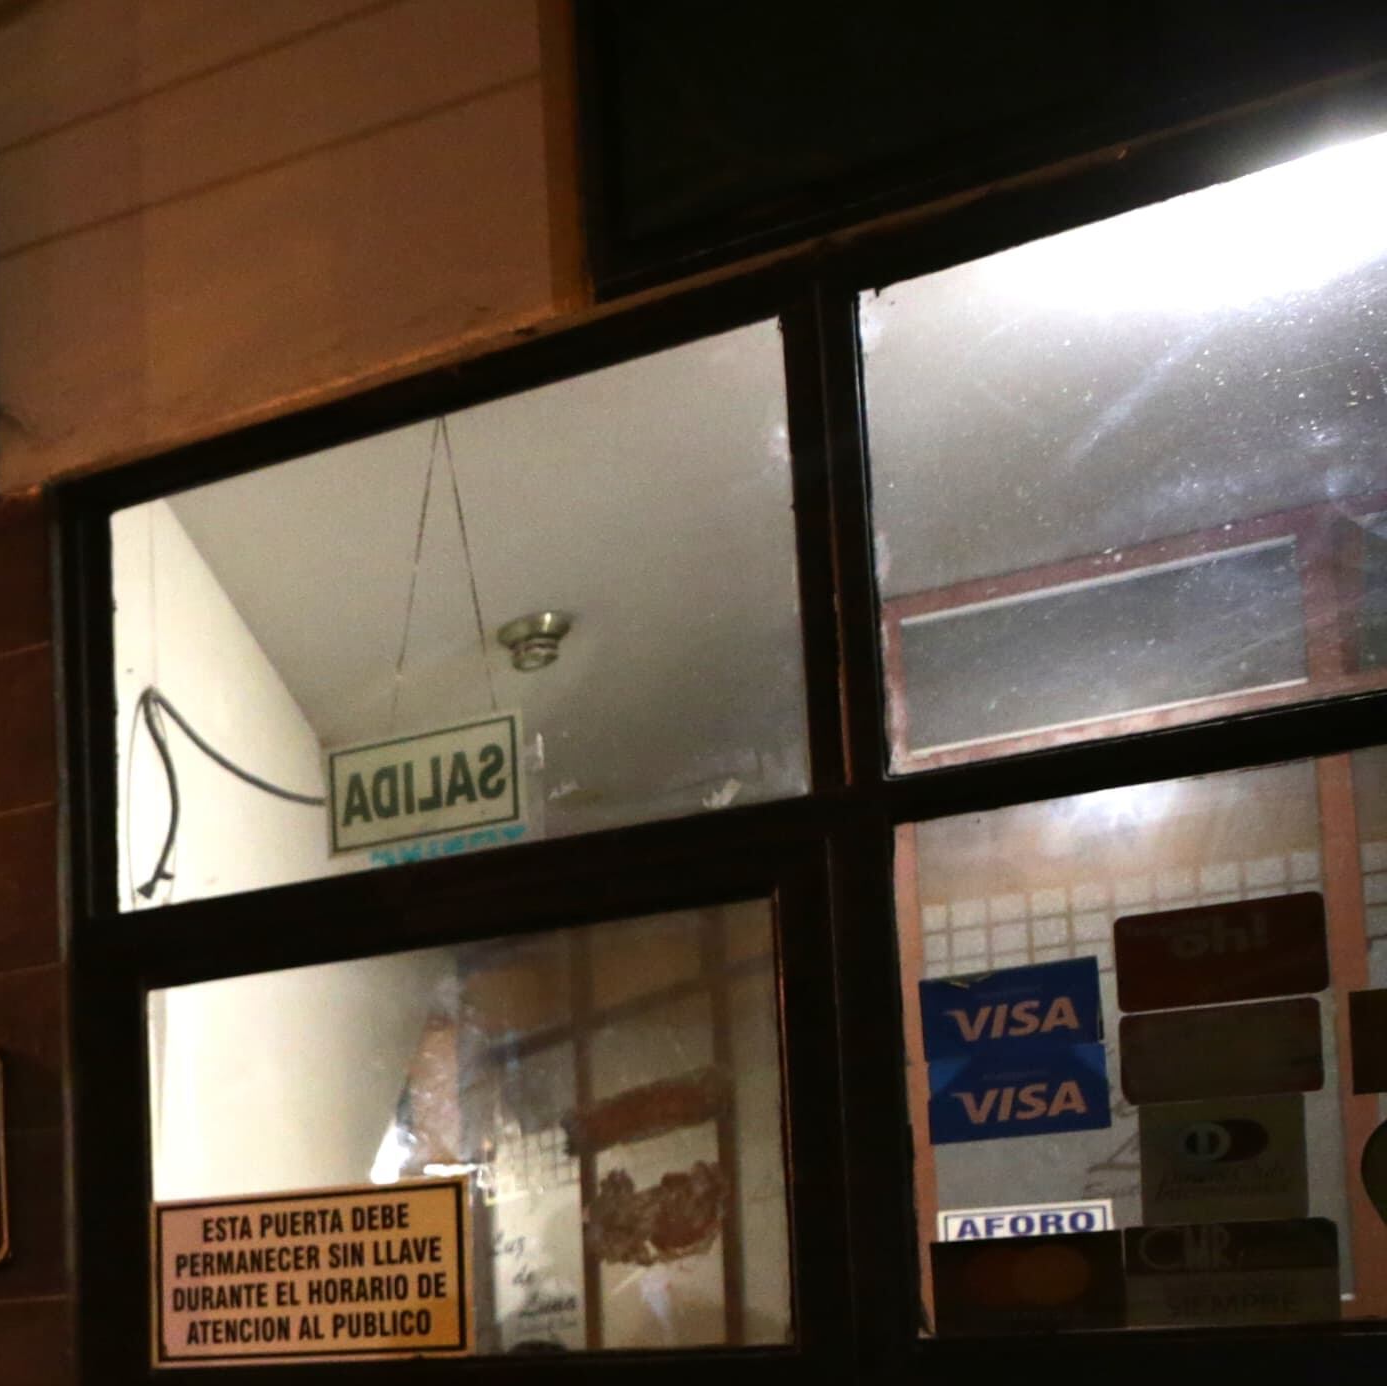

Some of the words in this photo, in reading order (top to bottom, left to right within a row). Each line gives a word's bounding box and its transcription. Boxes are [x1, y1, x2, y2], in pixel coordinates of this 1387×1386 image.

[942, 996, 1081, 1042] VISA
[950, 1080, 1089, 1126] VISA
[202, 1216, 252, 1243] ESTA
[260, 1209, 344, 1238] PUERTA
[352, 1203, 409, 1232] DEBE
[957, 1211, 1095, 1239] AFORO
[175, 1245, 320, 1278] PERMANECER
[328, 1242, 365, 1268] SIN
[372, 1237, 442, 1266] LLAVE
[172, 1283, 268, 1312] DURANTE
[276, 1281, 300, 1306] EL
[308, 1274, 409, 1304] HORARIO
[417, 1272, 447, 1299] DE
[1165, 1291, 1301, 1316] SMPRE
[187, 1316, 290, 1345] ATENCION
[299, 1314, 325, 1339] AL
[332, 1309, 432, 1338] PUBLICO
